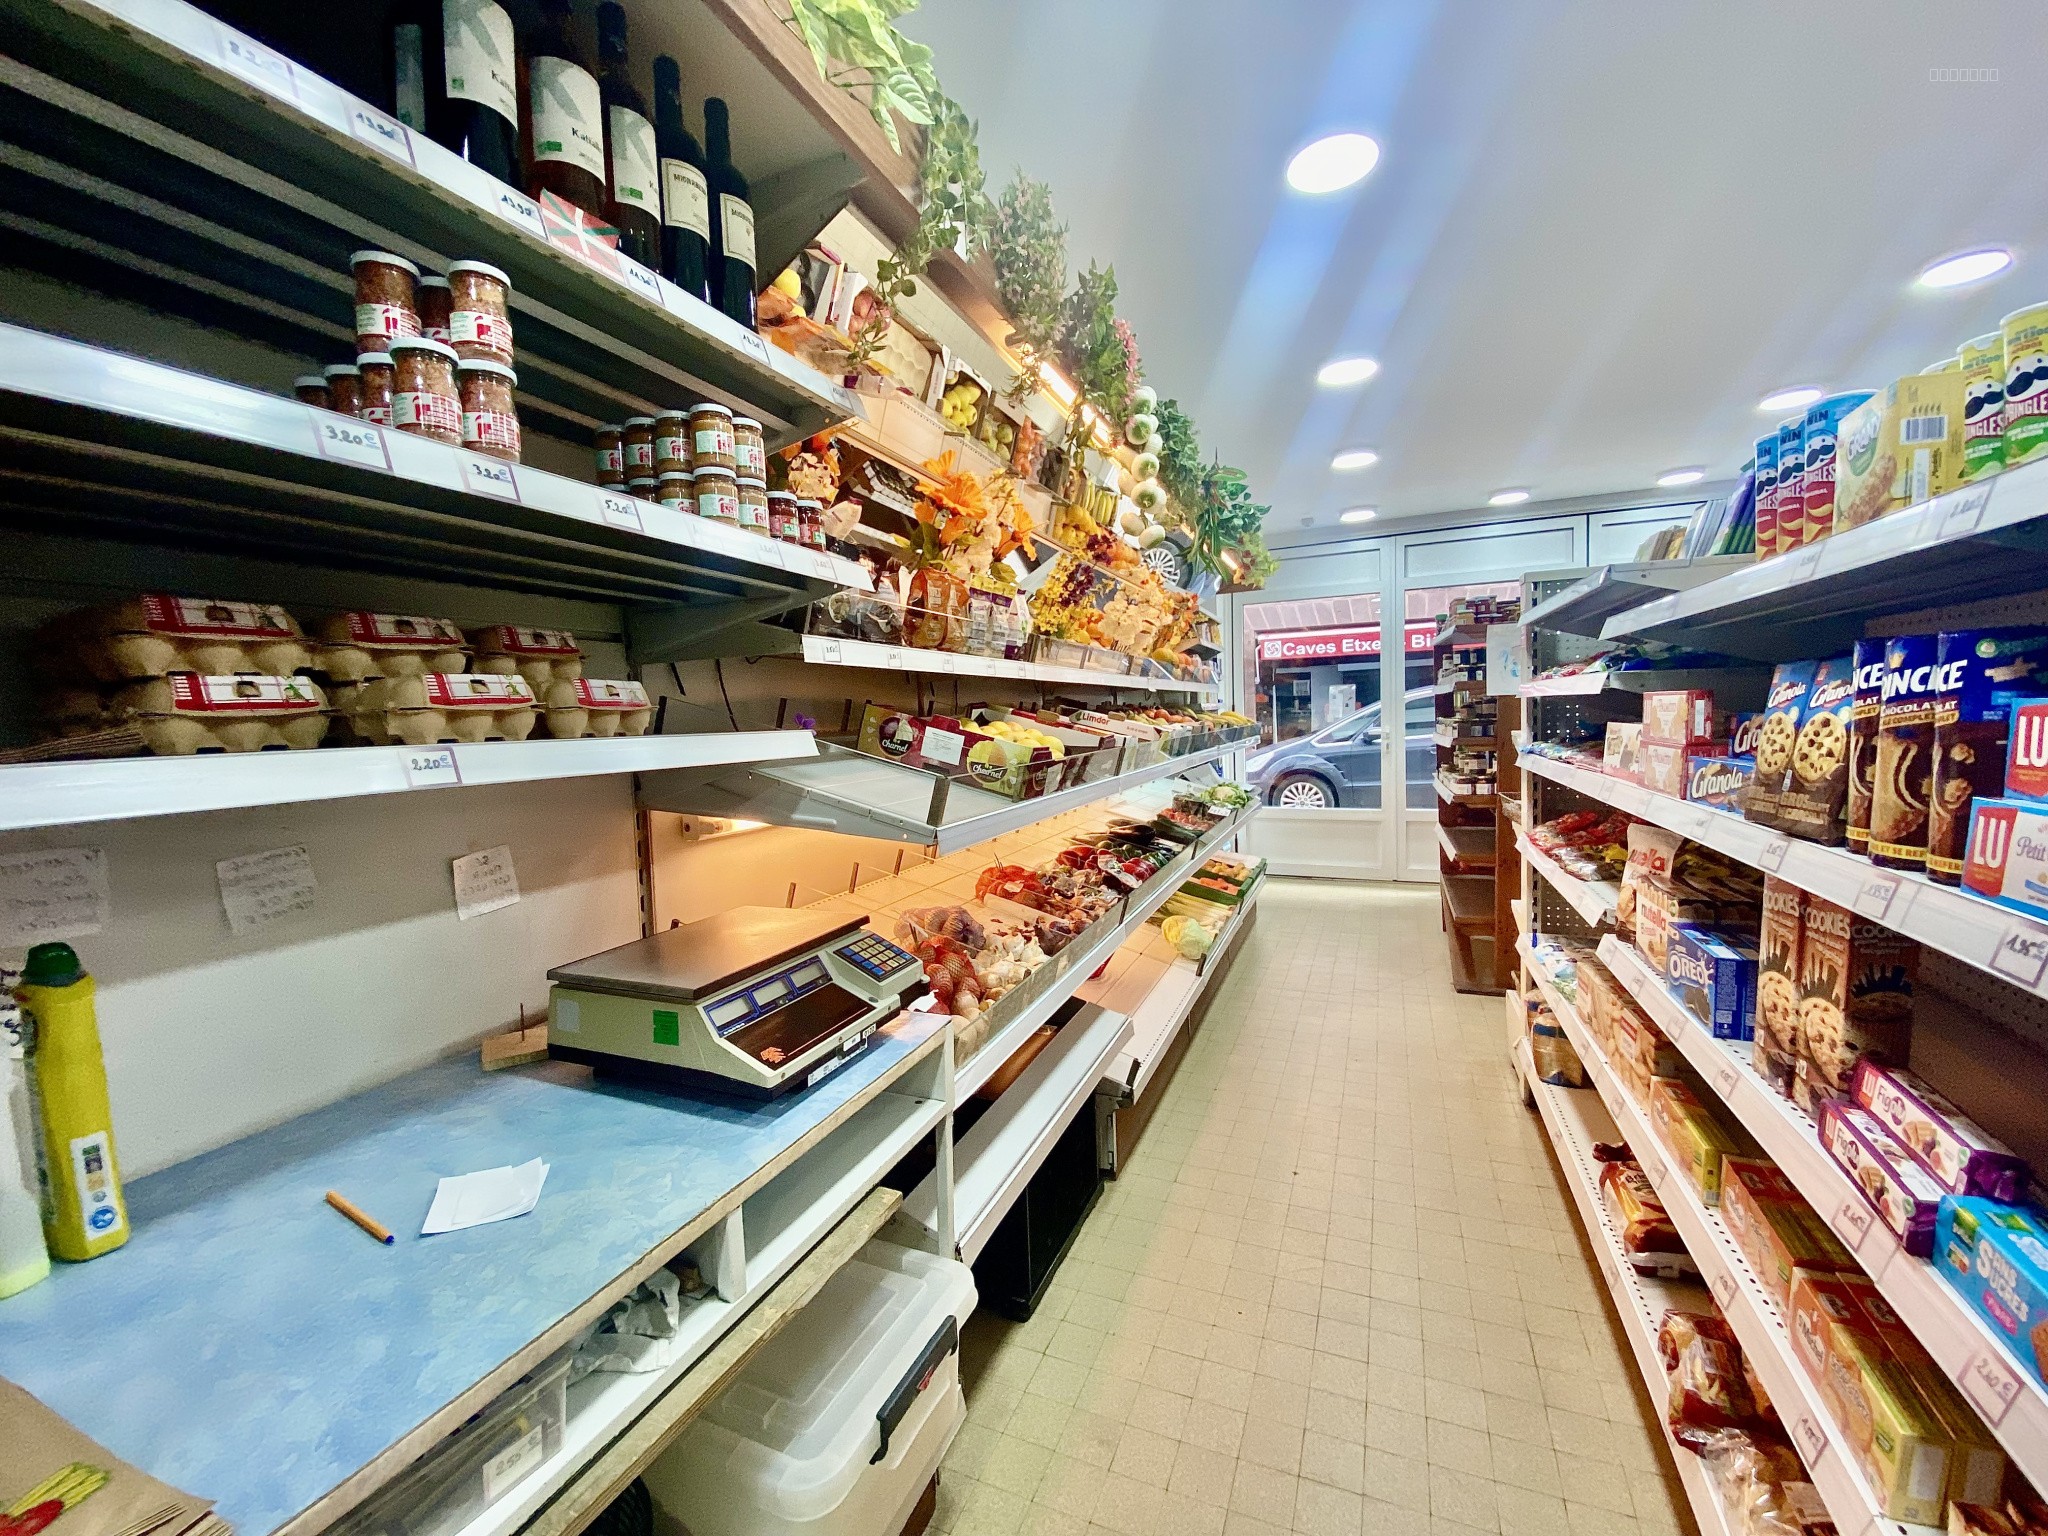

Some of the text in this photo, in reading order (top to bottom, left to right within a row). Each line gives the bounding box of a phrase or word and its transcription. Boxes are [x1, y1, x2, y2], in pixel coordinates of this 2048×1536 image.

[1283, 643, 1337, 657] Caves
[1767, 681, 1807, 709] Granola
[1082, 712, 1110, 726] Limdor
[881, 738, 908, 753] Charnel
[411, 754, 454, 771] 2.20€
[972, 764, 1004, 780] Charnel
[1691, 767, 1743, 799] Granola
[1973, 815, 2007, 869] LU
[1805, 907, 1850, 940] COOKIES
[1669, 954, 1708, 985] OREO
